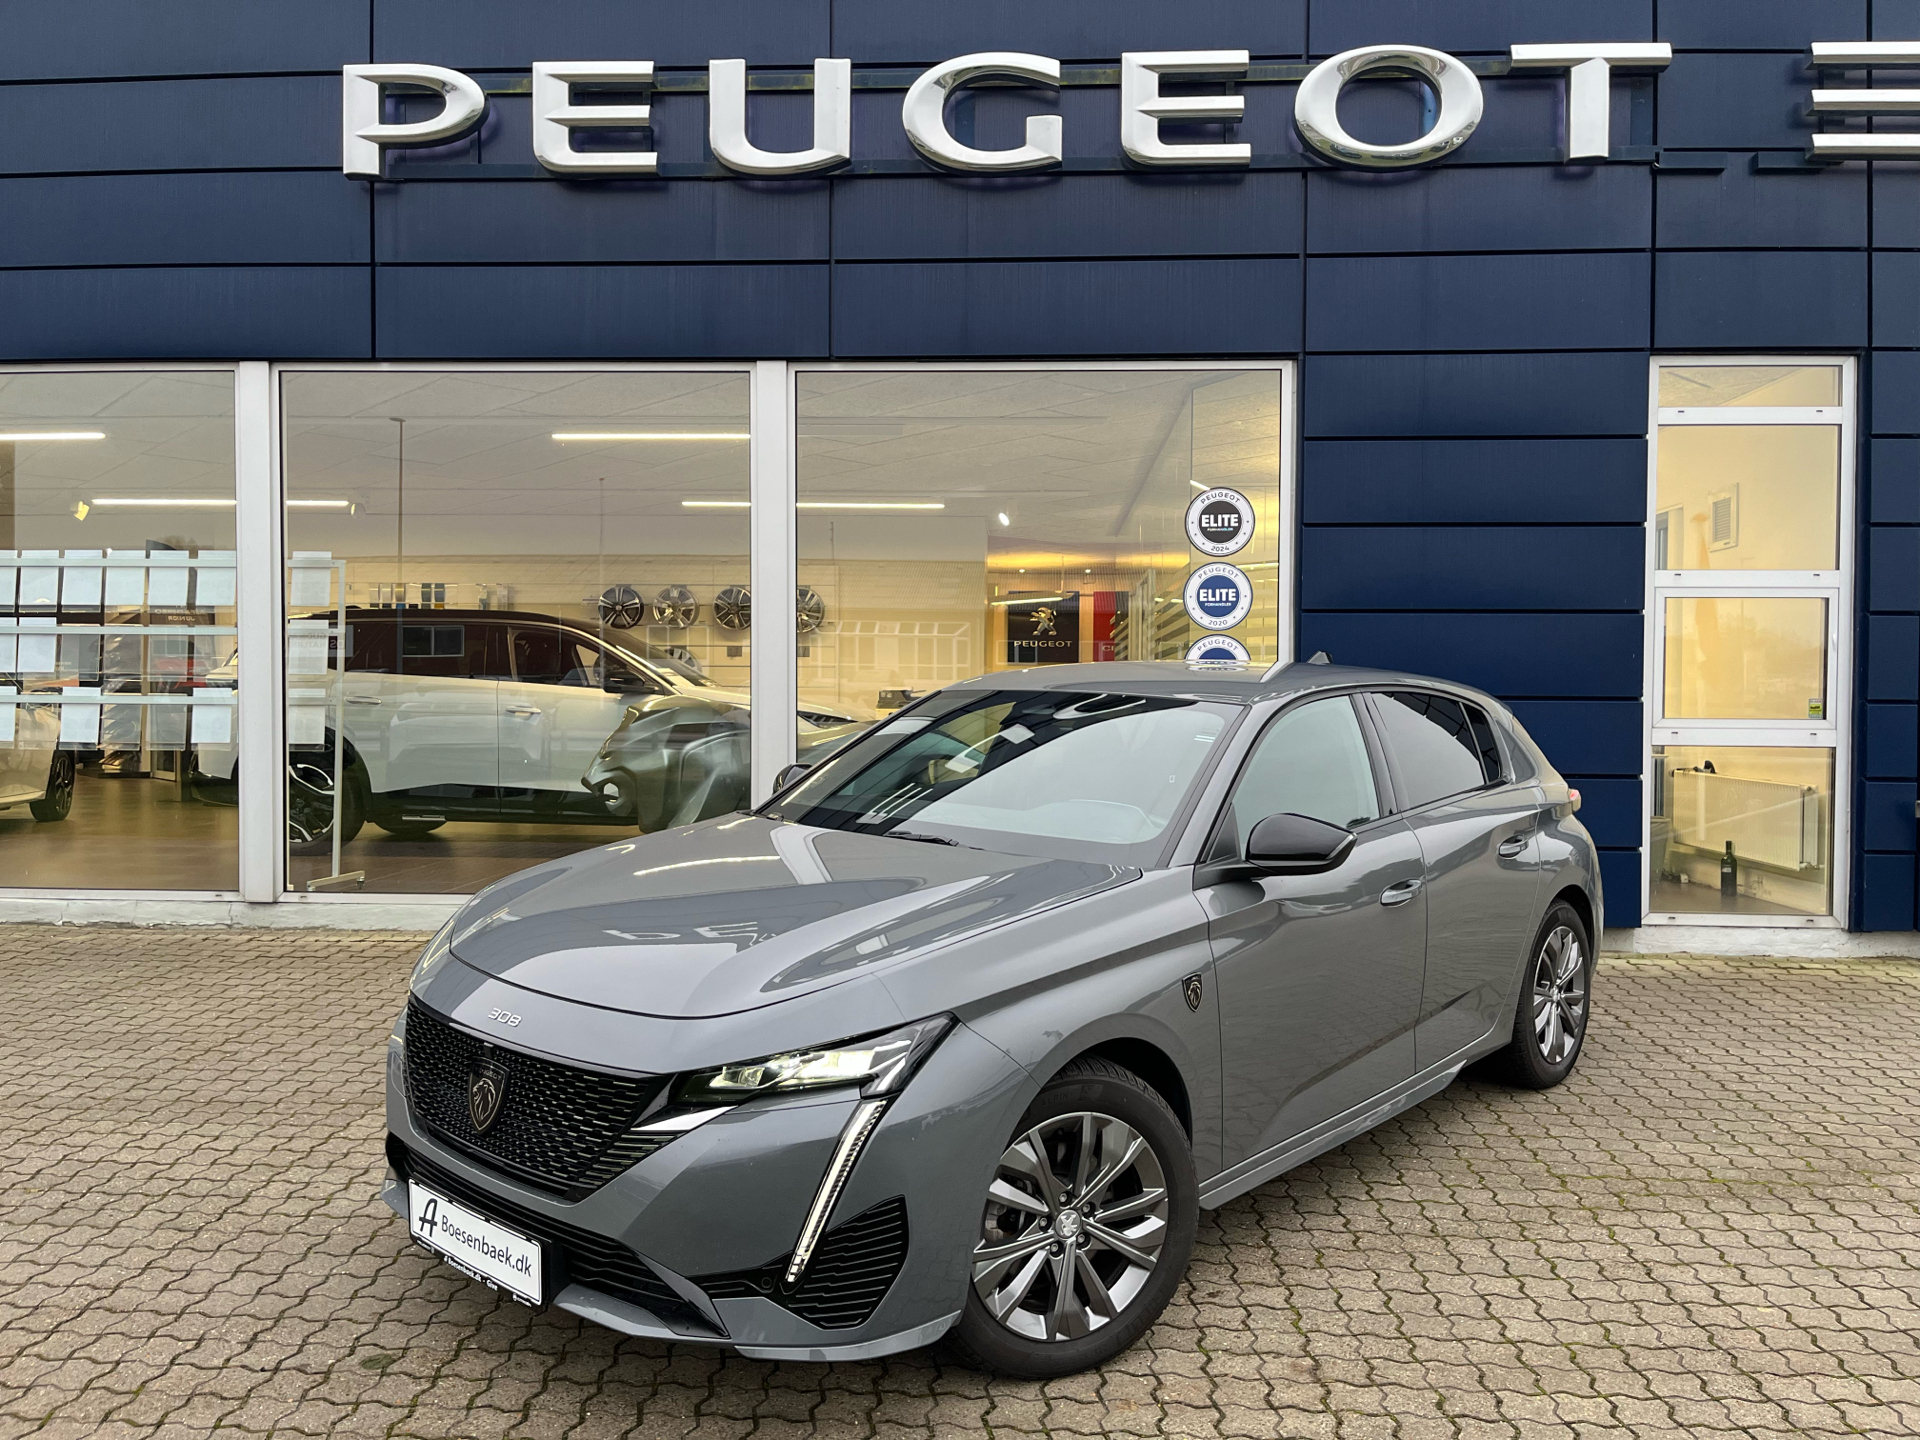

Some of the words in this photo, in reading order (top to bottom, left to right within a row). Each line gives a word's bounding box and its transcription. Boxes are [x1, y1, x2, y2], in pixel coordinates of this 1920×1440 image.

[343, 43, 1672, 181] PEUGEOT
[1200, 491, 1240, 504] PEUGEOT
[1201, 514, 1239, 527] ELITE
[1198, 566, 1239, 579] PEUGEOT
[1199, 588, 1237, 602] ELITE
[1208, 619, 1228, 627] 2020
[1013, 640, 1073, 648] PEUGEOT
[1197, 639, 1239, 652] PEUGEOT
[488, 1007, 522, 1027] 308
[441, 1214, 532, 1278] Boesenbaek.dk
